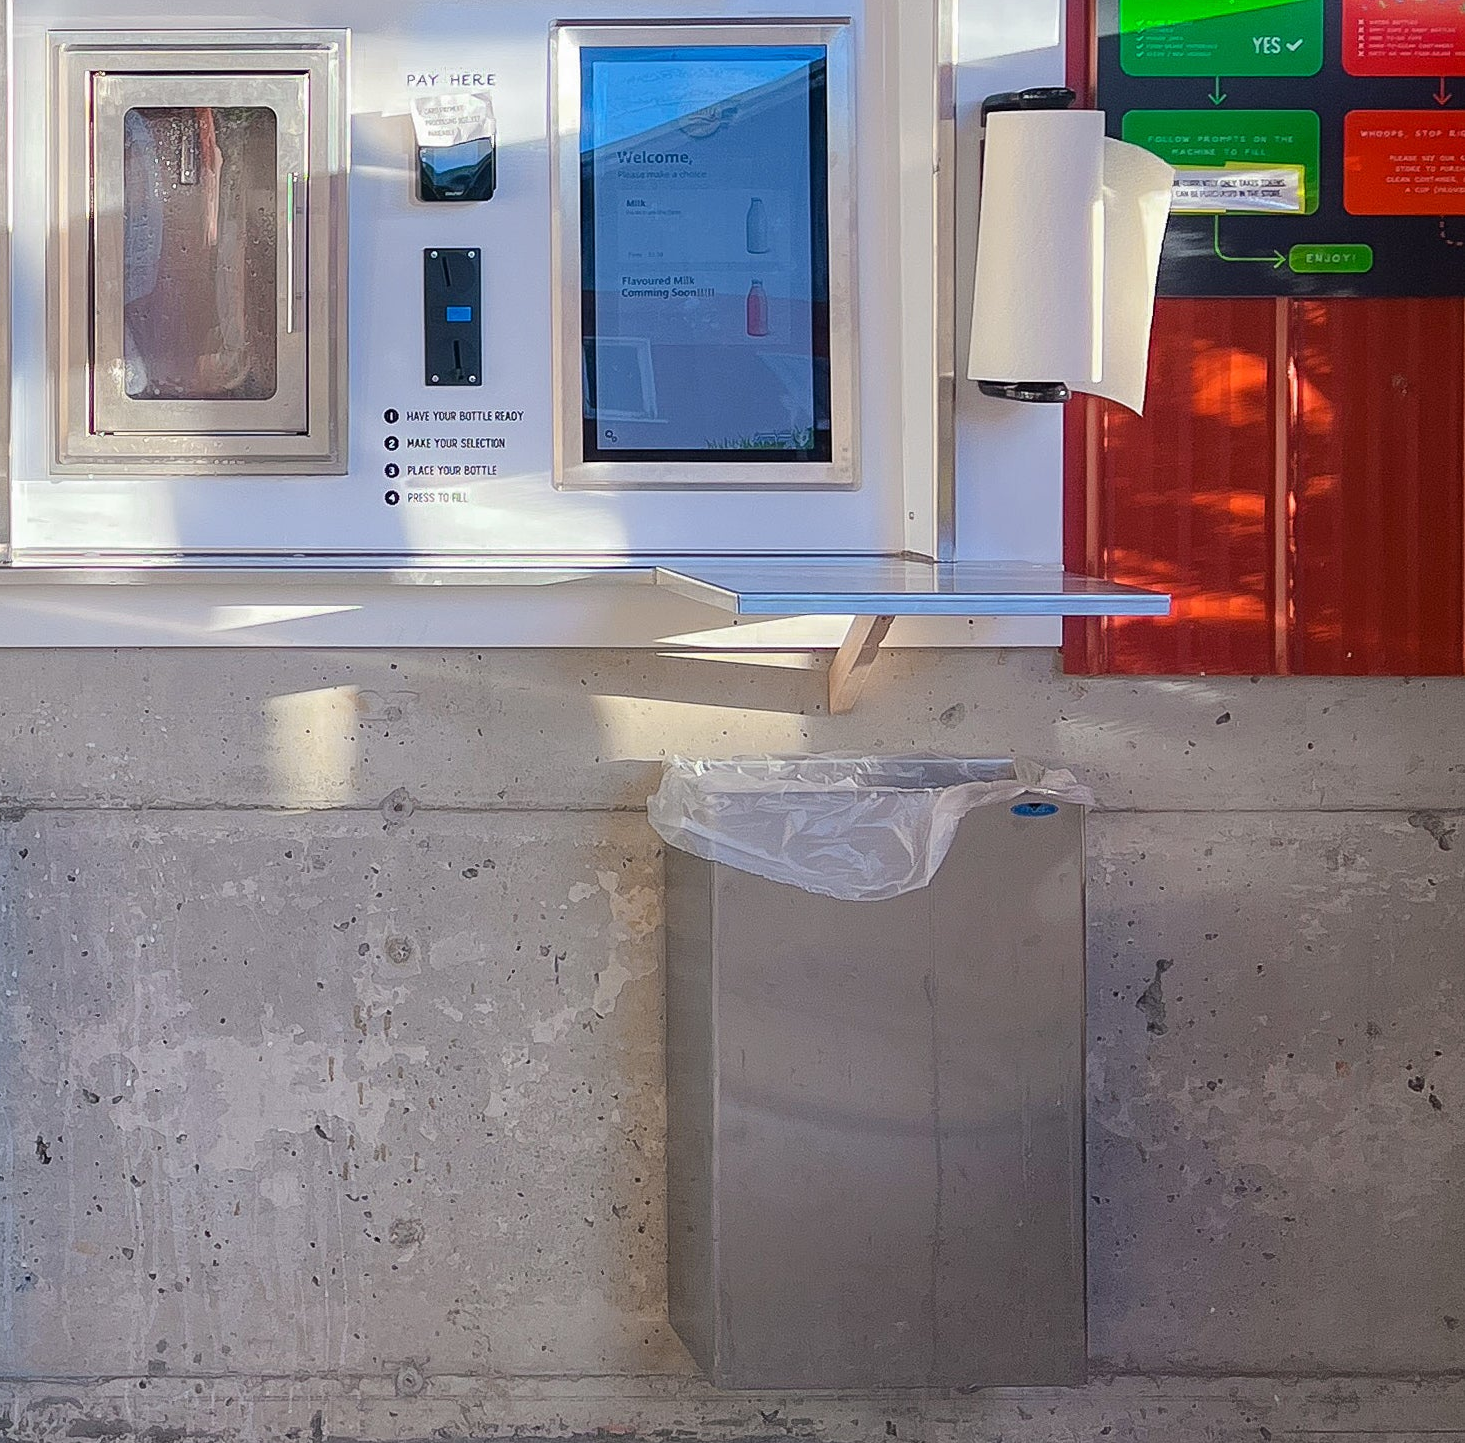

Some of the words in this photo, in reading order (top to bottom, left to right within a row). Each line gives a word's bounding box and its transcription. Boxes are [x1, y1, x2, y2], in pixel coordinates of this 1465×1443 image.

[1252, 36, 1281, 54] YES
[407, 74, 439, 87] PAY
[450, 74, 496, 87] HERE
[1415, 129, 1443, 137] STOP
[1147, 135, 1190, 143] FOLLOW
[1197, 135, 1246, 143] PROMPTS
[1253, 135, 1266, 143] ON
[1275, 135, 1294, 143] THE
[1171, 148, 1216, 156] MACHINE
[1223, 148, 1238, 156] TO
[1244, 148, 1266, 156] FILL
[616, 151, 693, 167] Welcome,
[626, 199, 646, 208] Milk
[621, 276, 671, 286] Flavoured
[673, 276, 695, 285] Milk
[621, 288, 669, 300] Comming
[406, 411, 430, 421] HAVE
[433, 411, 457, 421] YOUR
[459, 411, 493, 421] BOTTLE
[494, 410, 524, 421] READY
[407, 438, 431, 449] MAKE
[434, 438, 458, 449] YOUR
[460, 438, 506, 448] SELECTION
[407, 466, 434, 476] PLACE
[437, 466, 462, 476] YOUR
[464, 465, 497, 476] BOTTLE
[408, 493, 435, 503] PRESS
[437, 493, 450, 503] TO
[451, 493, 468, 503] FILL
